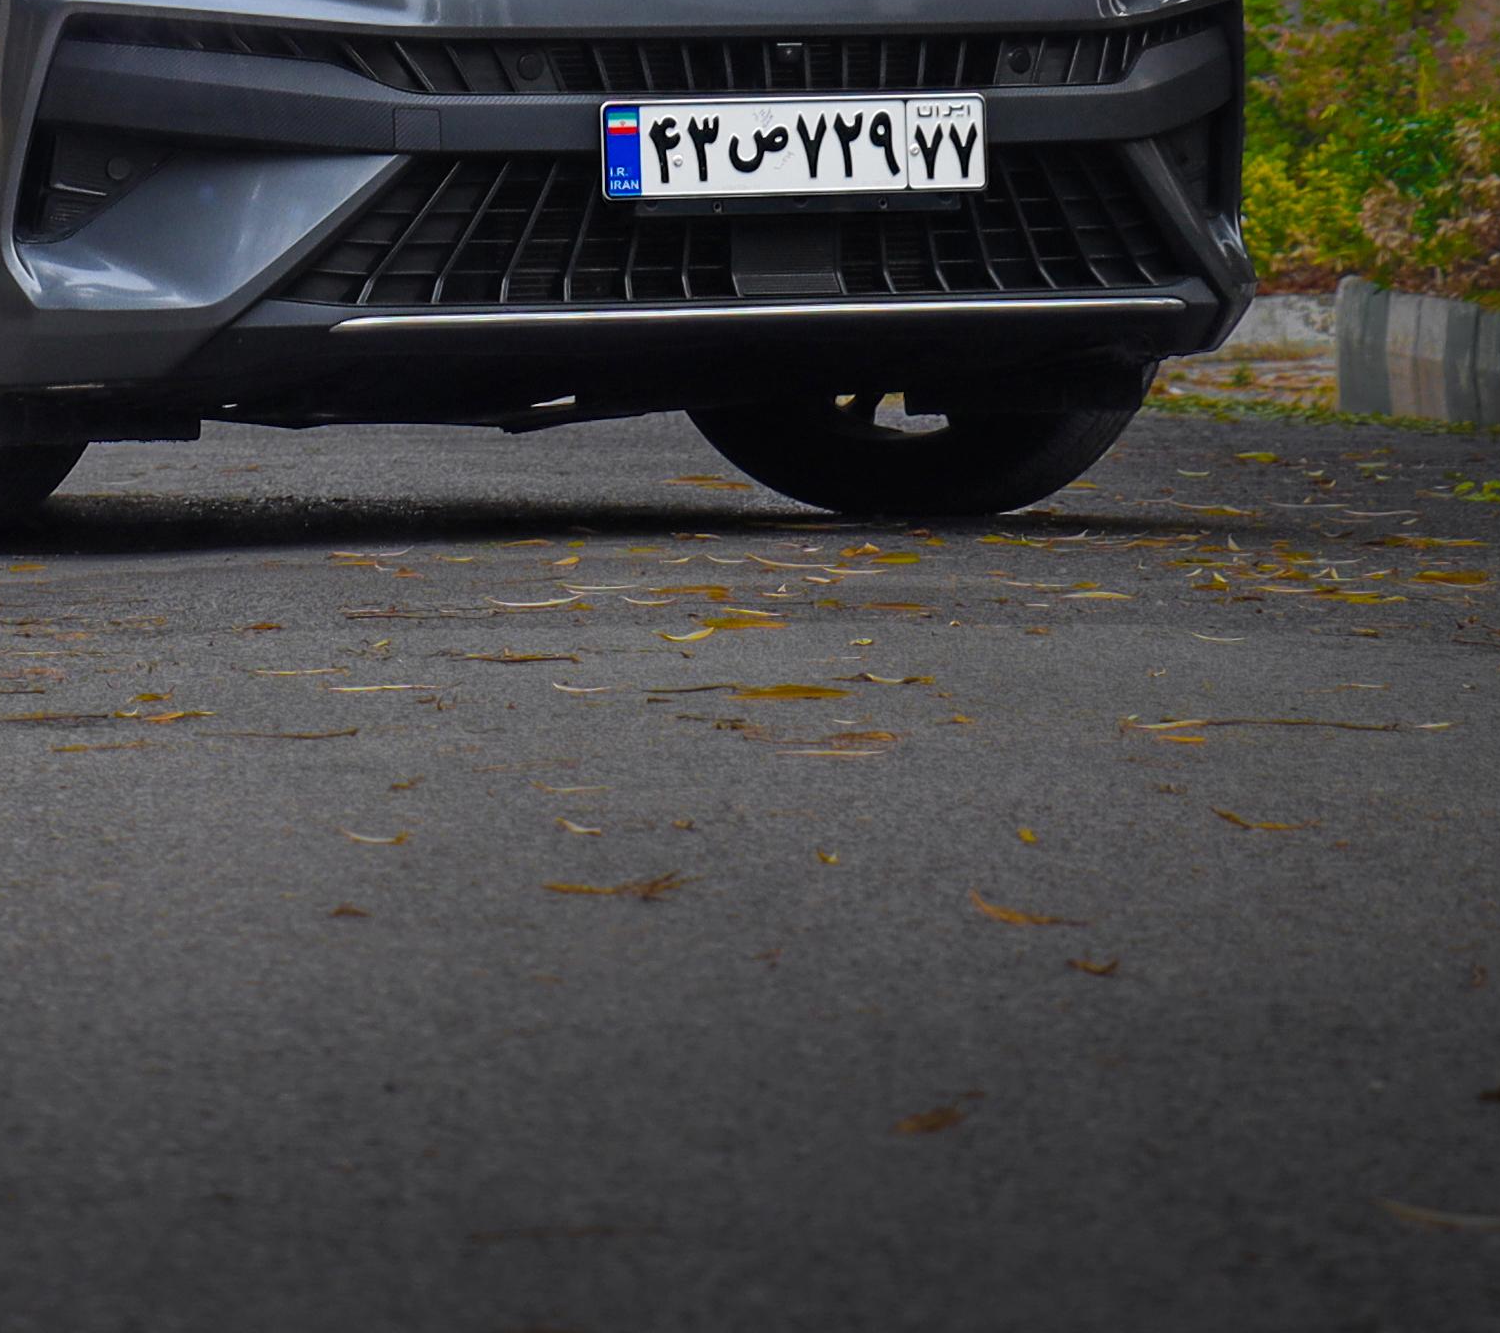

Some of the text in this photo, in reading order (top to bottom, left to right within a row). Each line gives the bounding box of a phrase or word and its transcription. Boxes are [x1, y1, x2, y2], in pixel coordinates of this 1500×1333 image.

[917, 104, 971, 118] ایران
[914, 122, 978, 180] ۷۷
[609, 167, 629, 177] I.R.
[609, 179, 640, 191] IRAN
